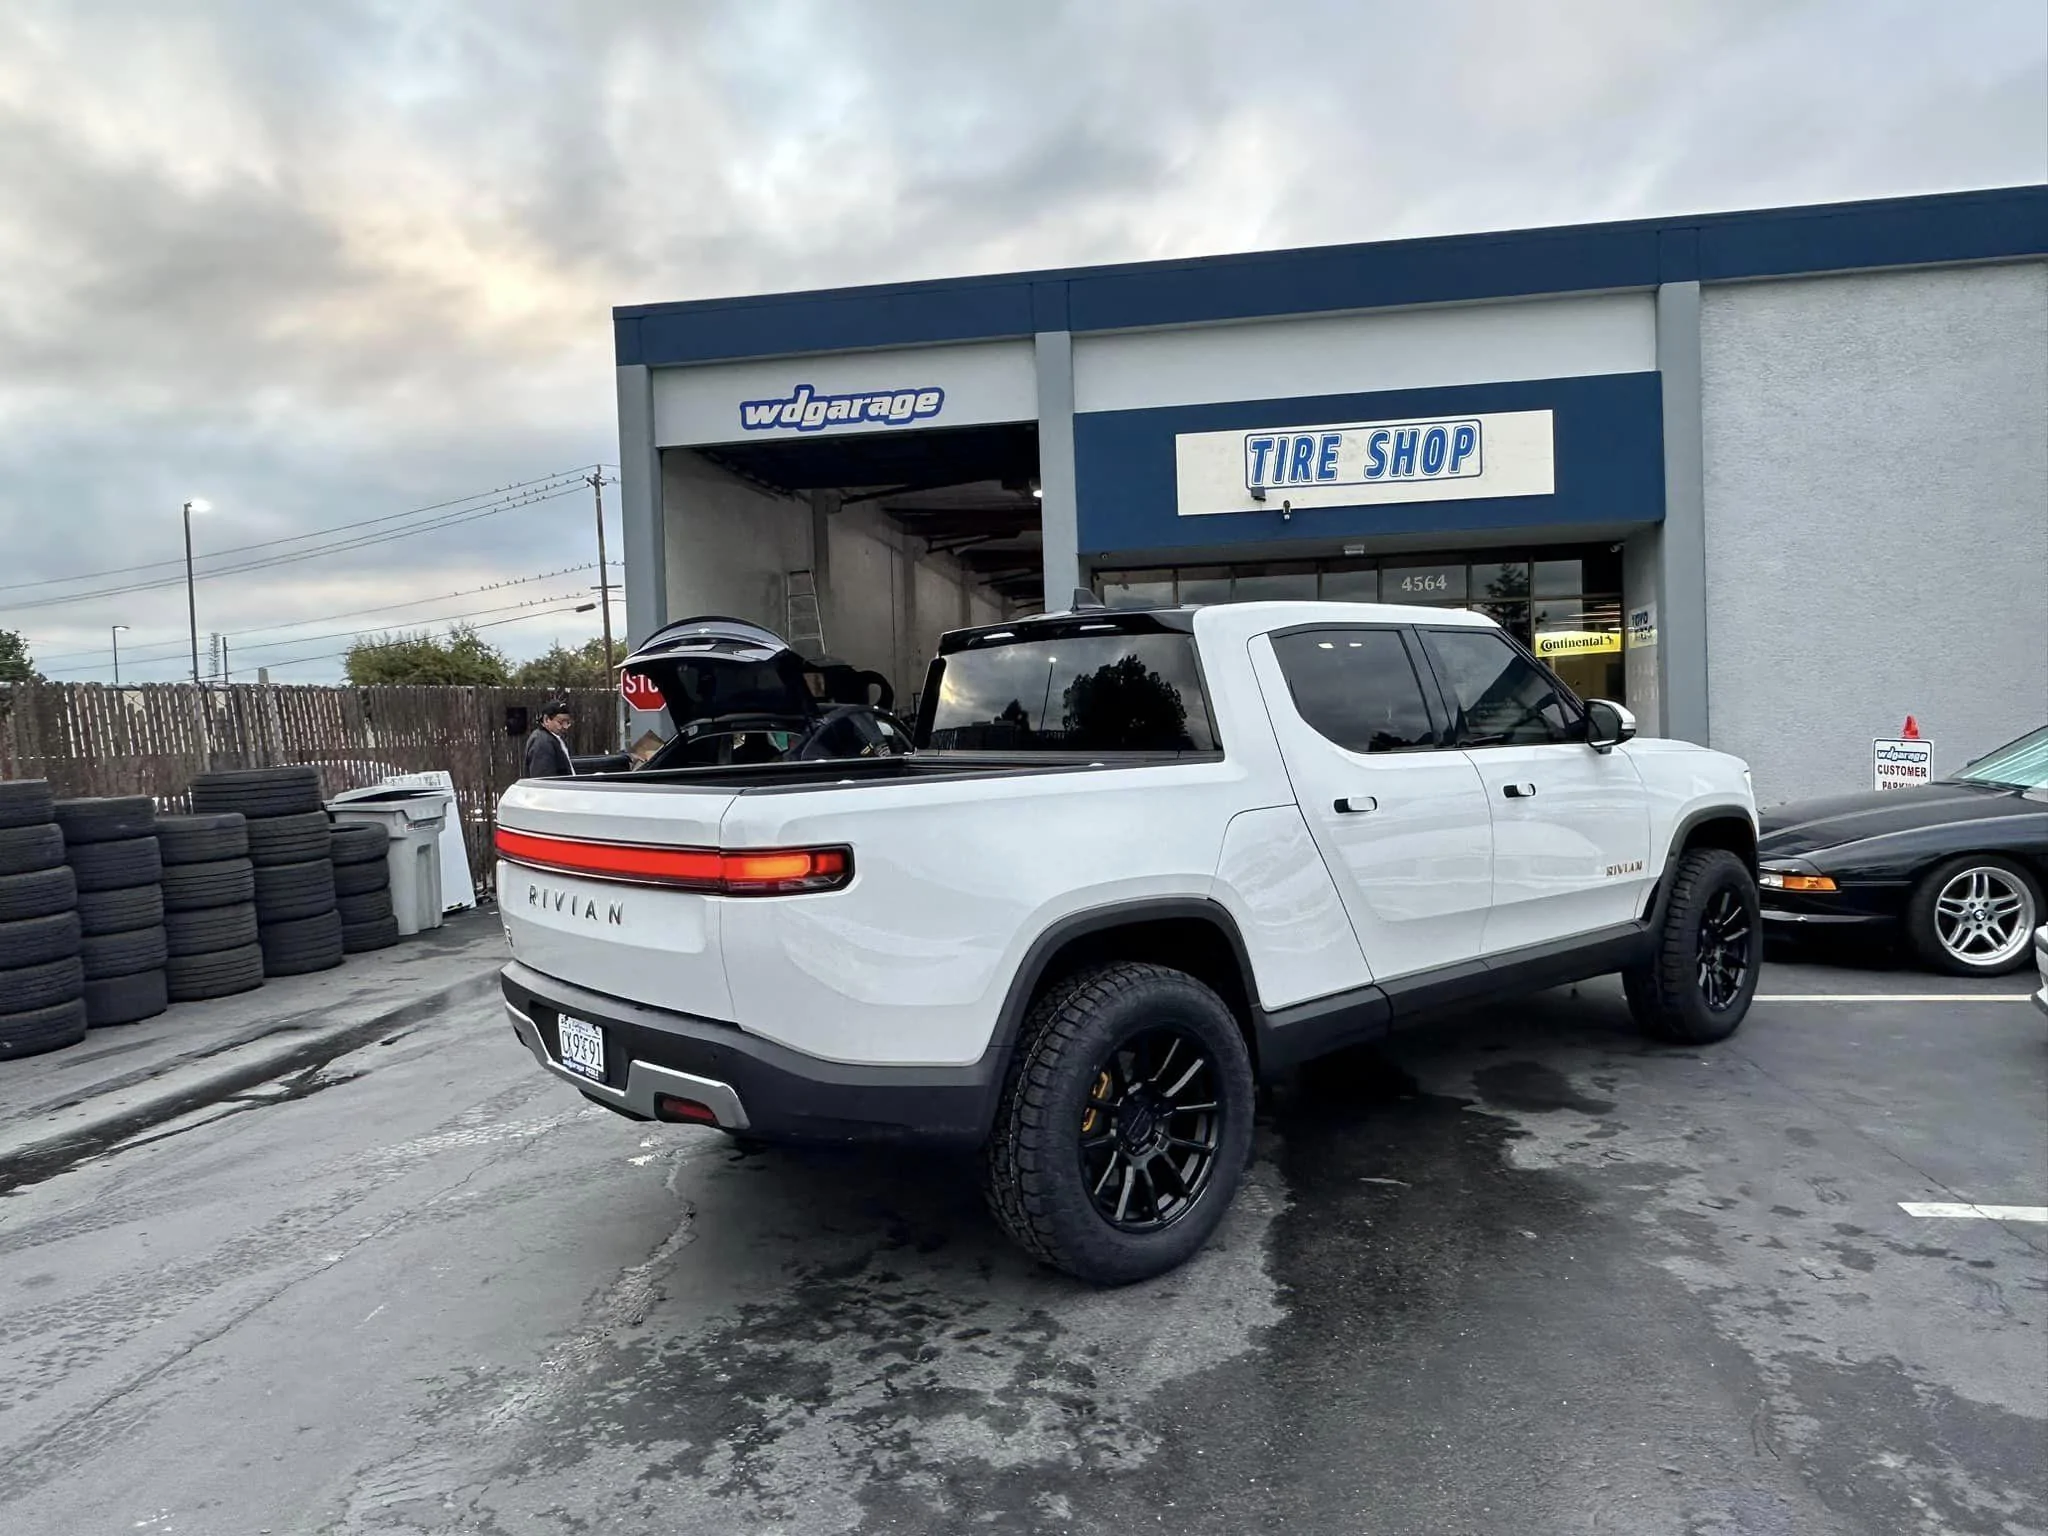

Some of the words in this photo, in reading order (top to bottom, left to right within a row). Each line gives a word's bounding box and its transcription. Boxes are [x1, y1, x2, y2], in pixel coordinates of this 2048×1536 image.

[743, 386, 943, 430] wdgarage
[1251, 434, 1342, 486] TIRE
[1364, 425, 1477, 480] SHOP
[1401, 574, 1448, 592] 4564
[1540, 635, 1604, 653] Continental
[1877, 746, 1928, 763] wdgarage
[1877, 764, 1927, 777] CUSTOMER
[1606, 859, 1643, 877] RIVIAN
[528, 884, 624, 926] RIVIAN
